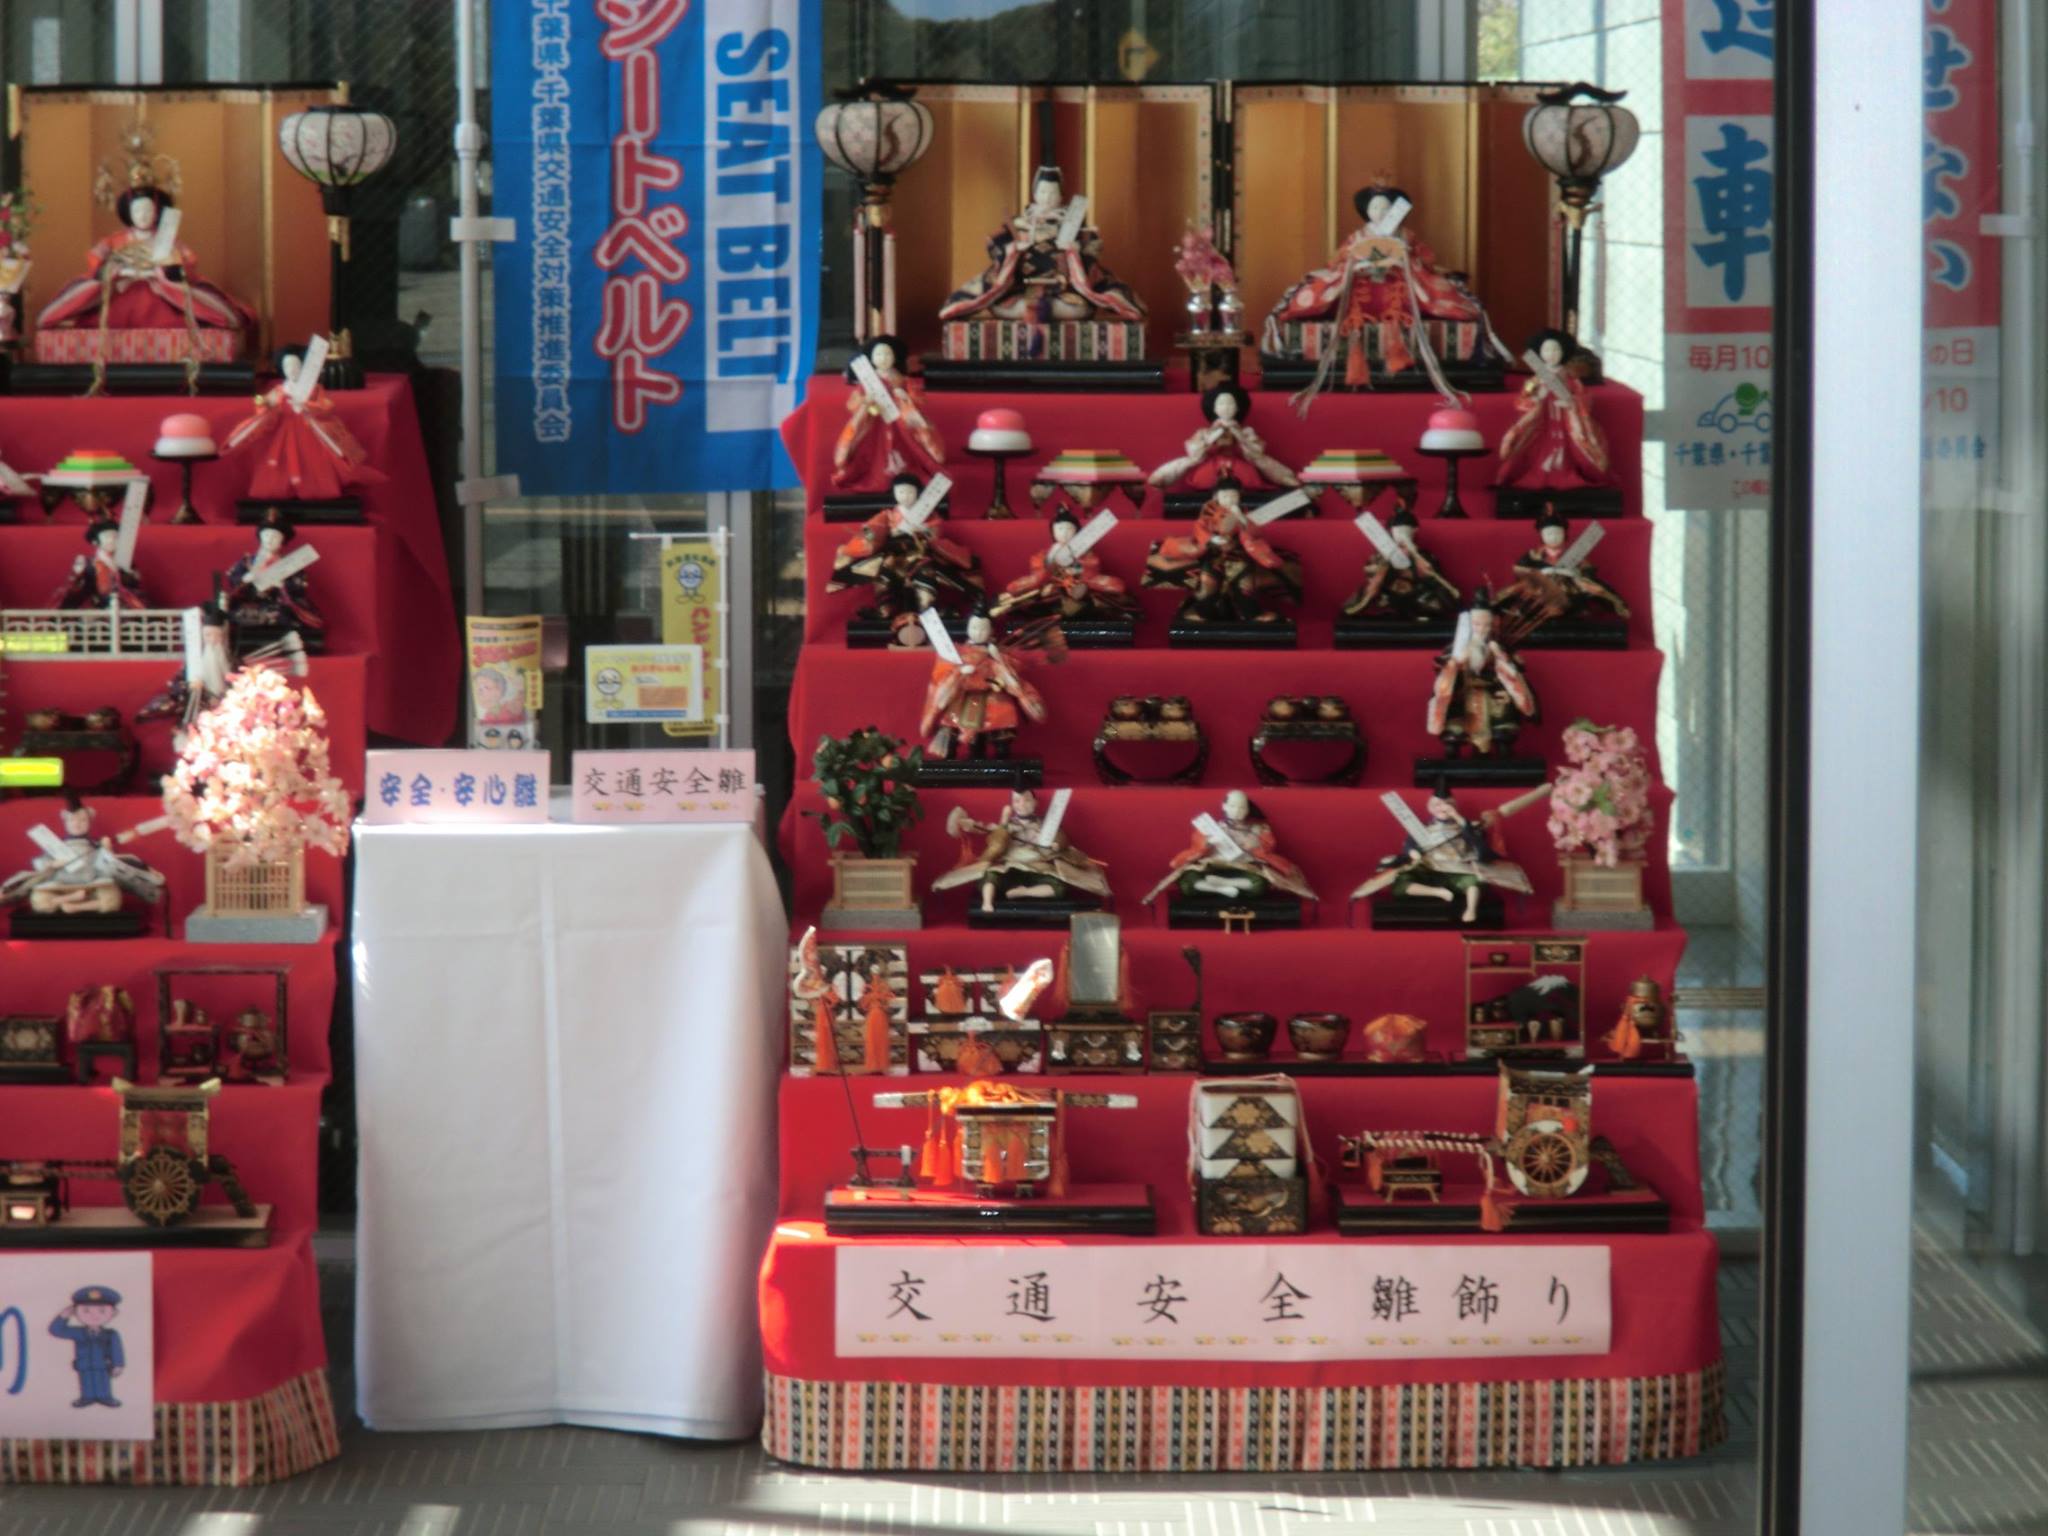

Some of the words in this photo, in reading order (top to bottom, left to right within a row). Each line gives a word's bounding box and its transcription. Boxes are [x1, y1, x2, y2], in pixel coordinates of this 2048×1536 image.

[715, 28, 791, 205] SEAT
[717, 223, 792, 385] BELT
[583, 766, 748, 798] 交通安全雛
[885, 1269, 1573, 1325] 交通安全雛飾り
